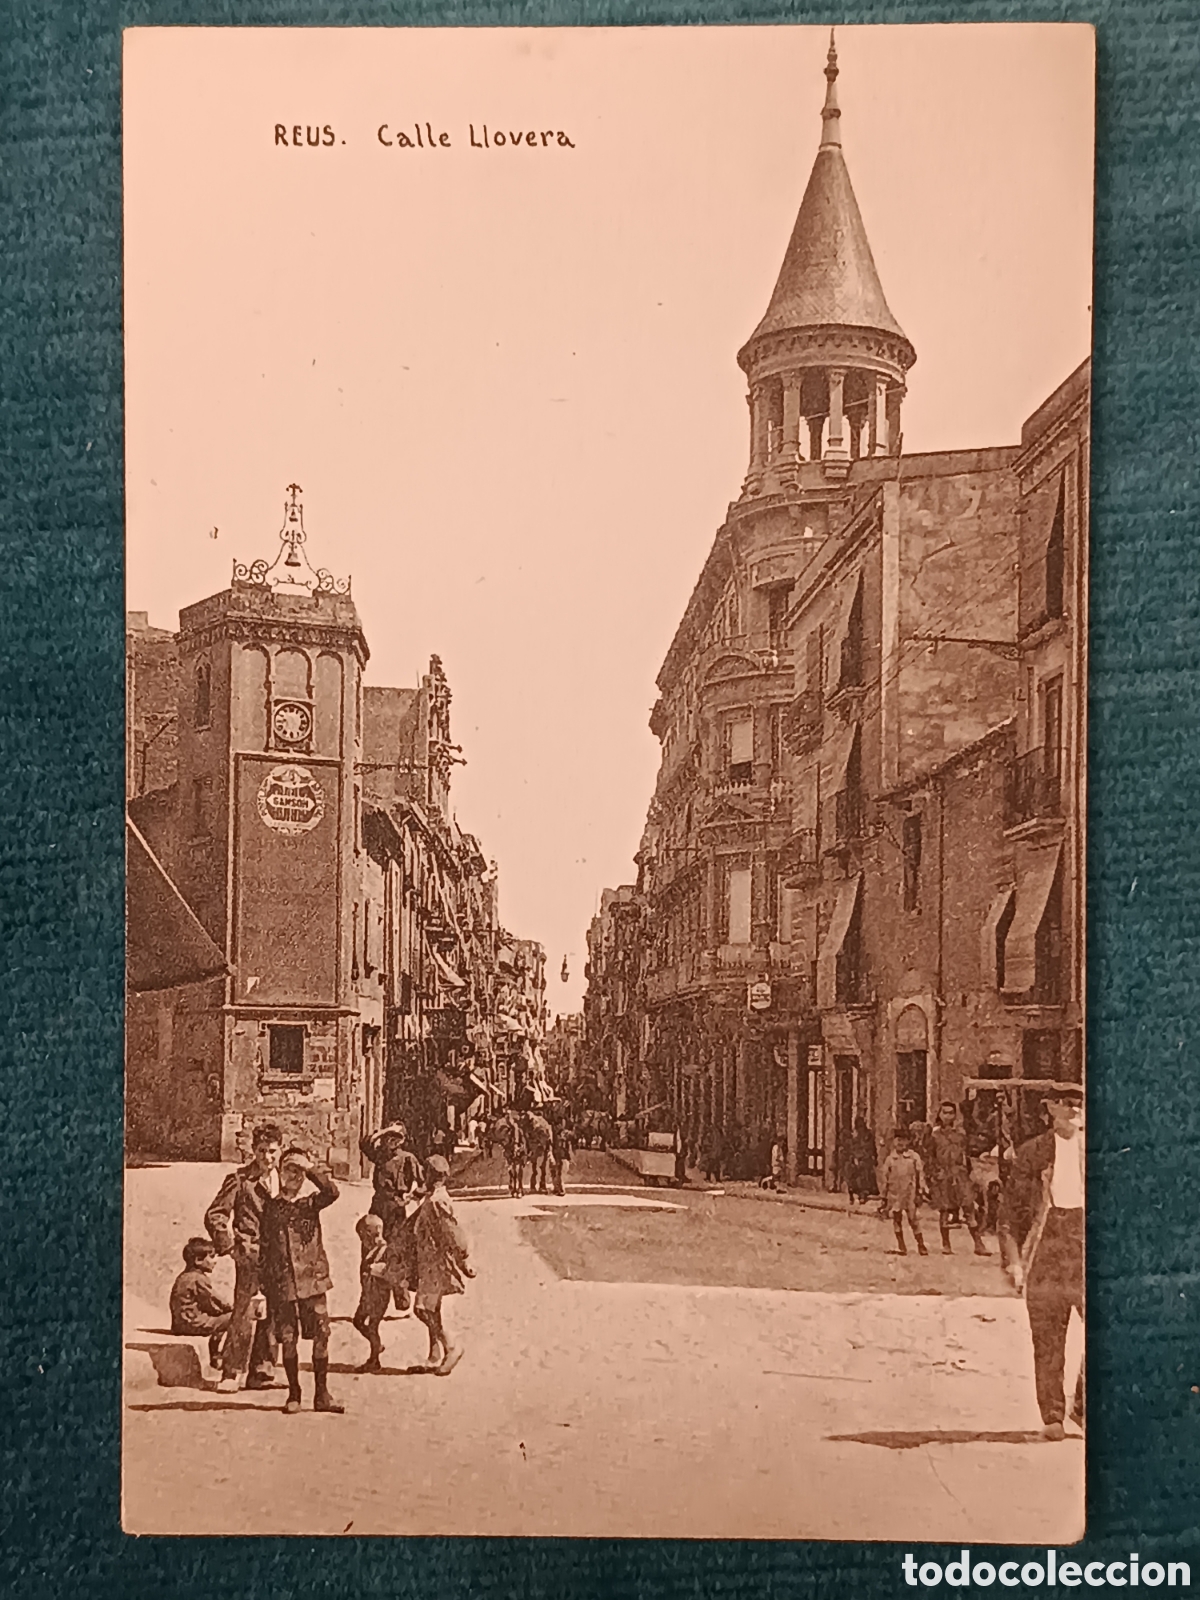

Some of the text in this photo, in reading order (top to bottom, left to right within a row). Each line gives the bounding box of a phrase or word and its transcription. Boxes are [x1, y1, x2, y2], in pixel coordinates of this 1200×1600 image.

[274, 122, 576, 149] REUS. Calle Llovera
